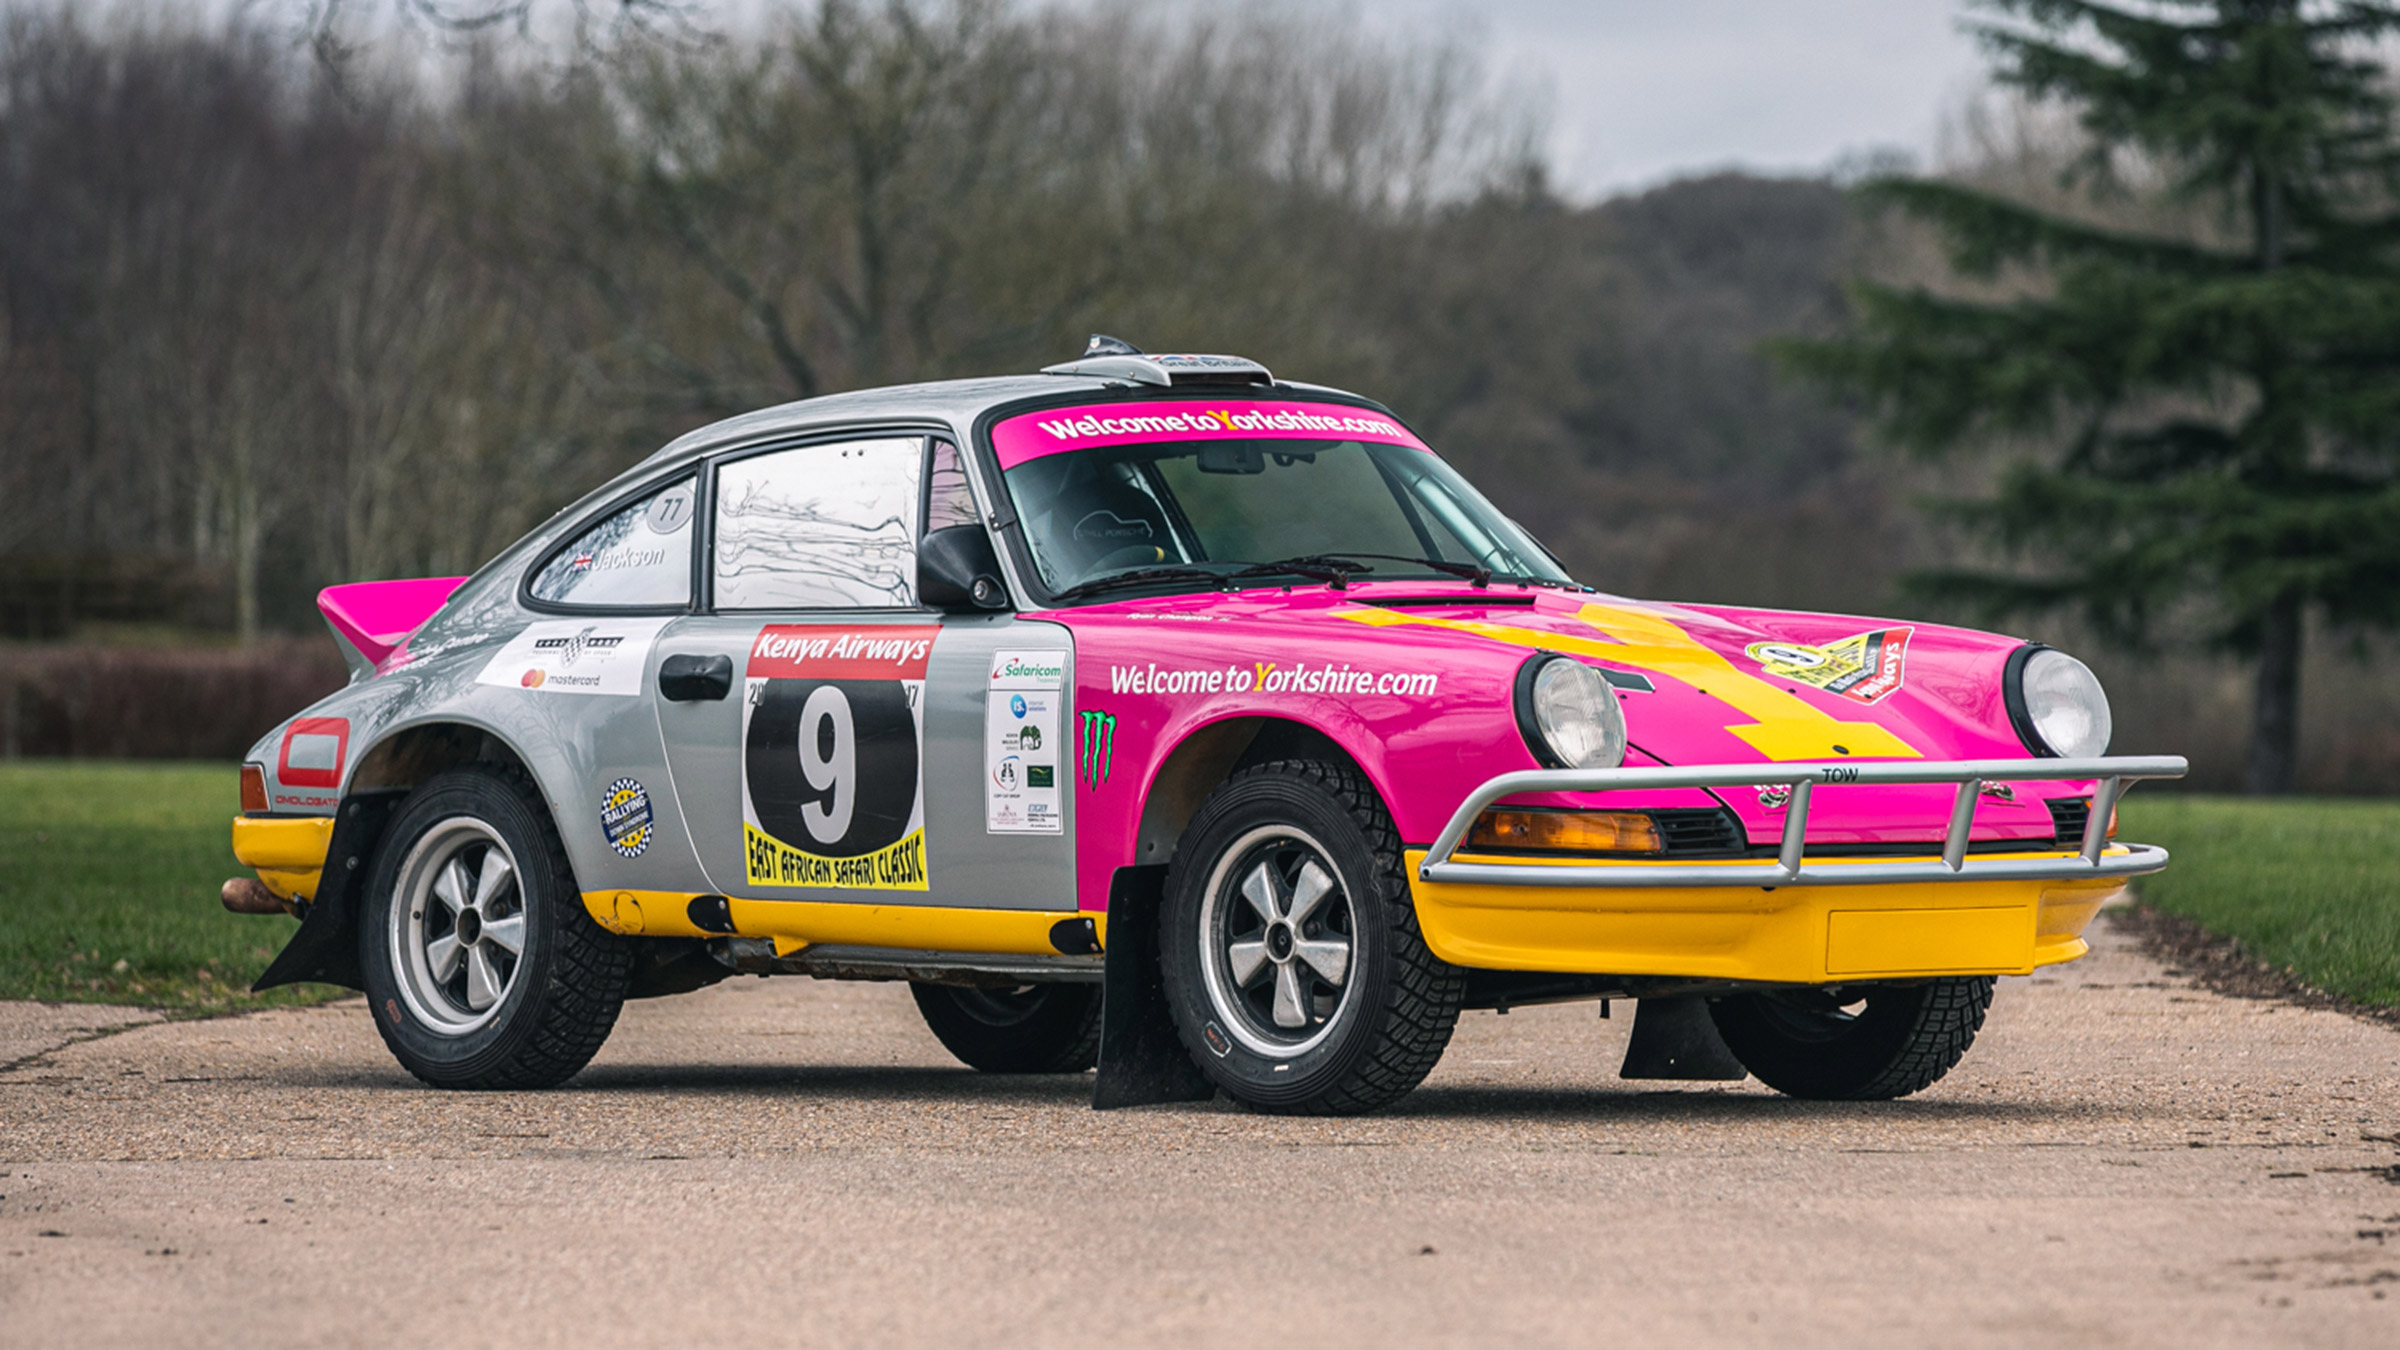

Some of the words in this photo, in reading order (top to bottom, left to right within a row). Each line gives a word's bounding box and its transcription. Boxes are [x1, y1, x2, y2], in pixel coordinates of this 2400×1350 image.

[661, 497, 684, 521] 77
[592, 547, 665, 572] Jackson
[754, 633, 823, 665] Kenya
[832, 634, 930, 666] Airways
[548, 674, 601, 687] mastercard
[1005, 663, 1062, 676] Safaricom
[798, 685, 855, 845] 9
[1822, 767, 1859, 783] TOW
[604, 795, 646, 825] RALLYING
[748, 829, 777, 880] EAST
[781, 850, 831, 883] AFRICAN
[835, 855, 875, 886] SAFARI
[878, 834, 923, 887] CLASSIC
